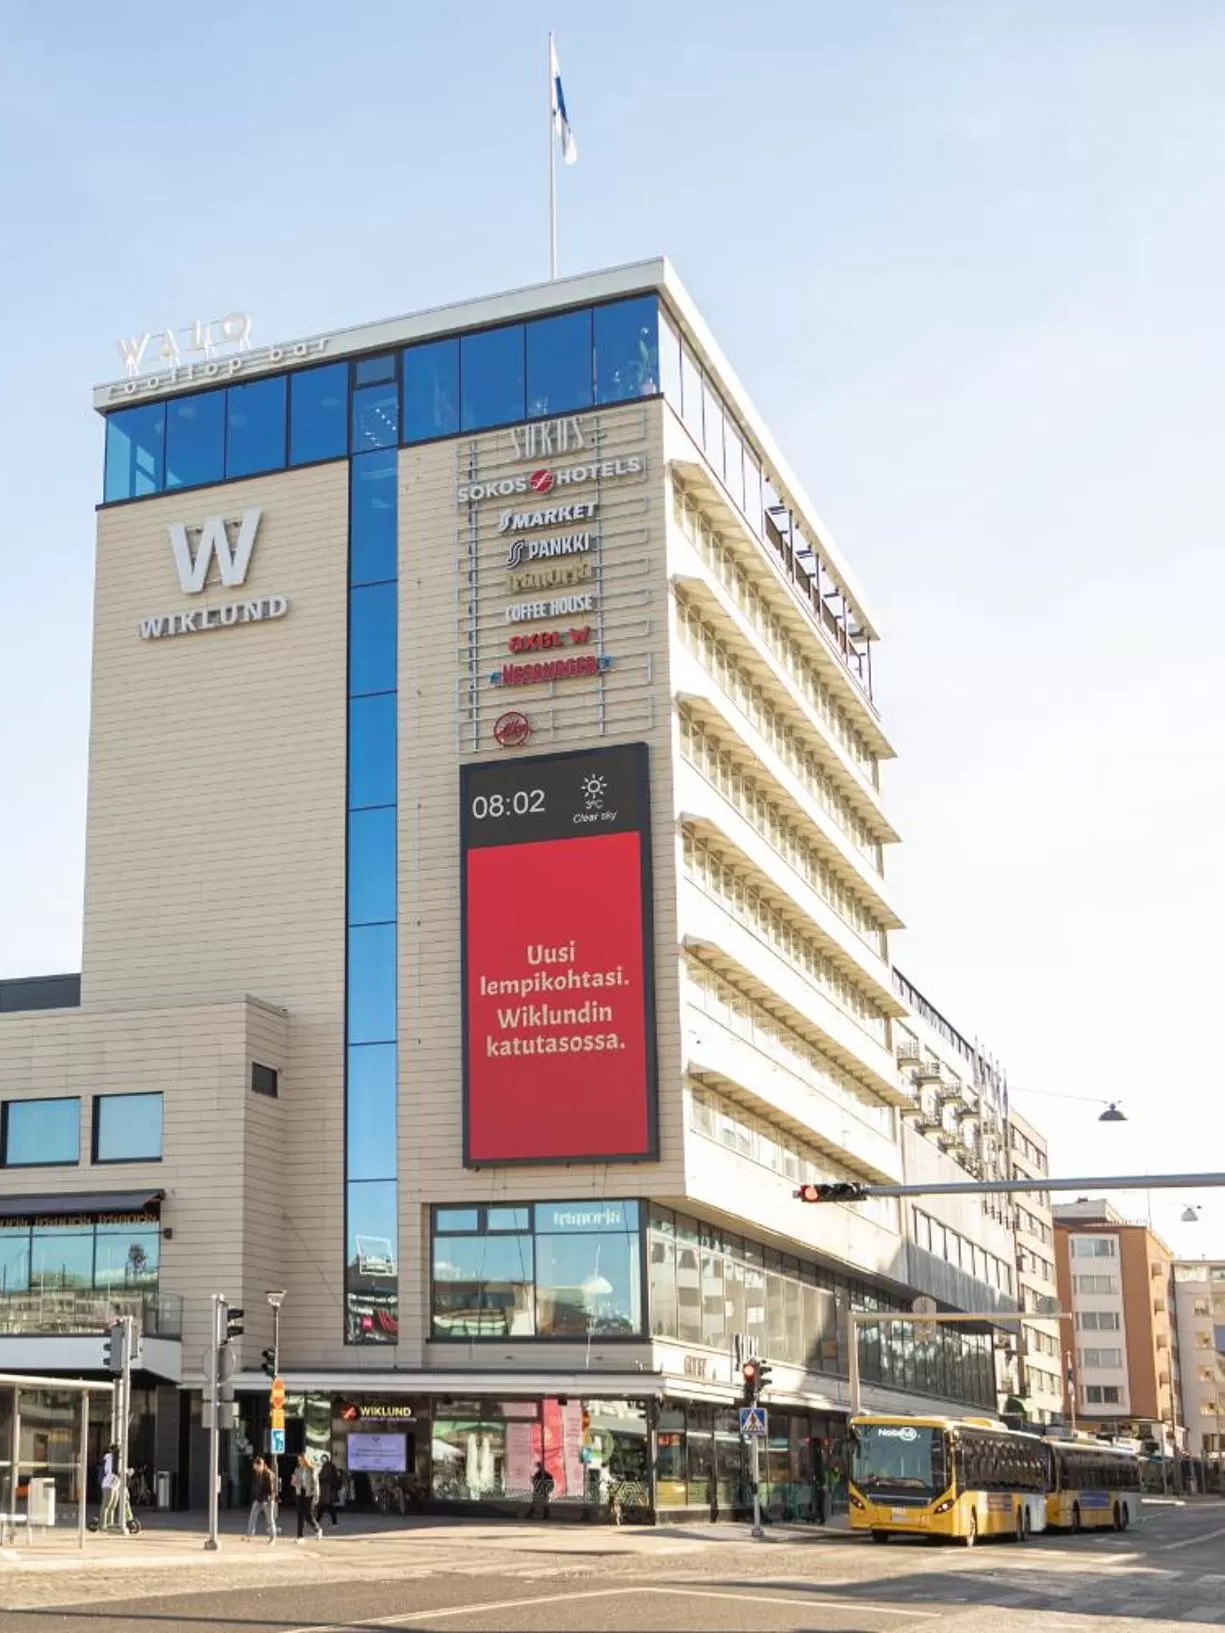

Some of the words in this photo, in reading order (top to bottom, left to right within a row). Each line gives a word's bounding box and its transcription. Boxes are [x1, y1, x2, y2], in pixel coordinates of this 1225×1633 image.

[269, 338, 331, 361] bar
[458, 476, 527, 503] SOKOS
[556, 456, 642, 485] HOTELS
[168, 505, 262, 595] W
[528, 533, 591, 559] PANKKI
[141, 595, 288, 640] WIKLUND
[506, 603, 547, 622] COFFEE
[550, 594, 592, 616] HOUSE
[472, 789, 546, 819] 08:02
[527, 940, 575, 965] Uusi
[480, 966, 629, 998] lempikohtasi.
[497, 1001, 613, 1029] Wiklundin
[486, 1033, 625, 1057] katutasossa.
[360, 1405, 412, 1417] WIKLUND
